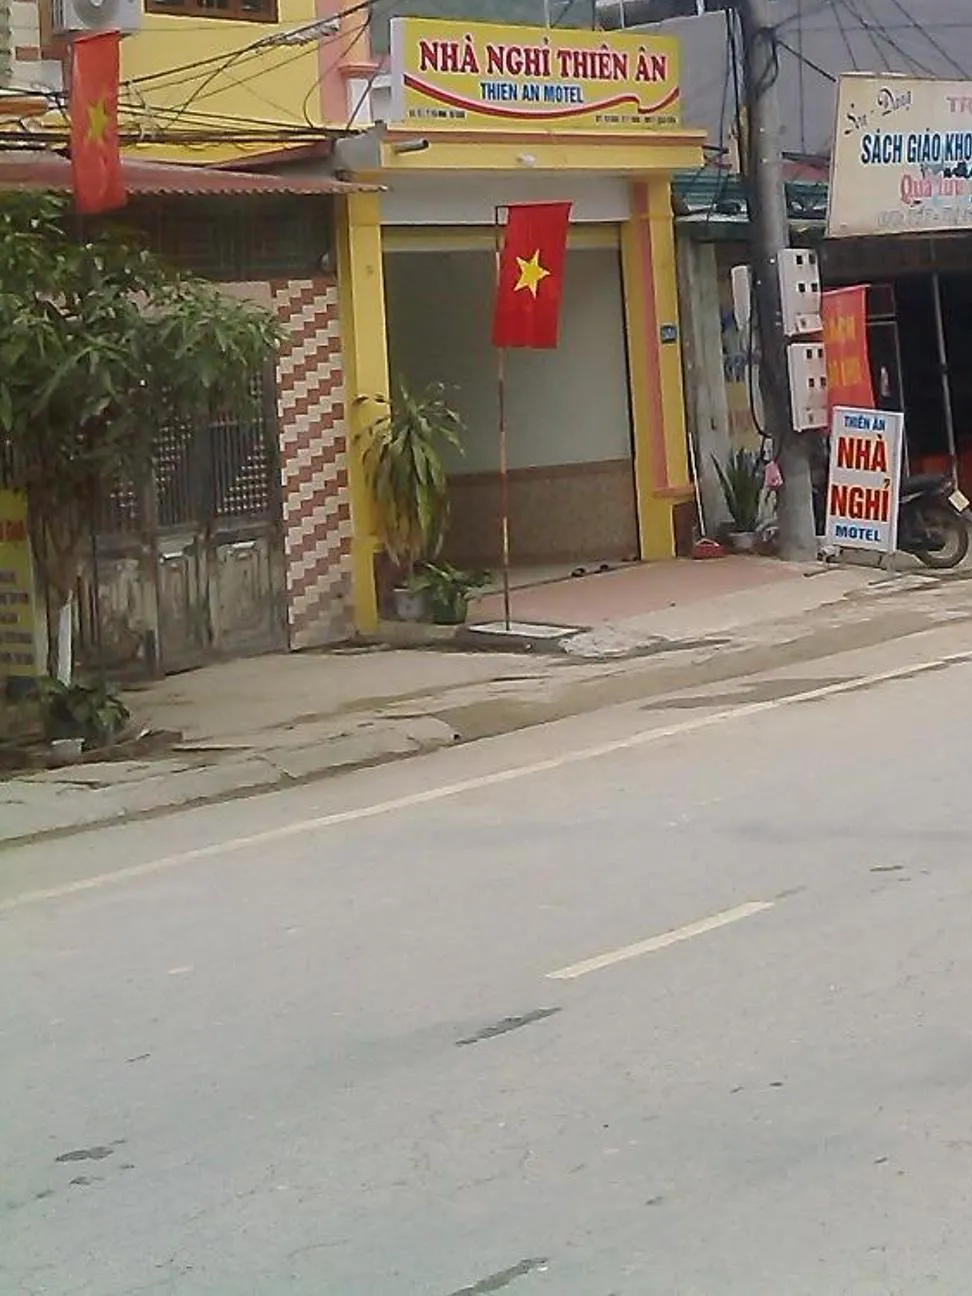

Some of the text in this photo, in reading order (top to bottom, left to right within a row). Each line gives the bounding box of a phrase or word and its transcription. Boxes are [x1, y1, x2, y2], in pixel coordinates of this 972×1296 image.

[419, 34, 479, 74] NHÀ
[557, 43, 628, 81] THIÊN
[635, 46, 667, 82] ÂN
[480, 82, 584, 103] THIEN AN MOTEL
[861, 128, 902, 164] SÁCH
[907, 127, 941, 164] GIÁO
[837, 433, 888, 473] NHÀ
[830, 478, 892, 523] NGHỈ
[835, 524, 882, 543] MOTEL
